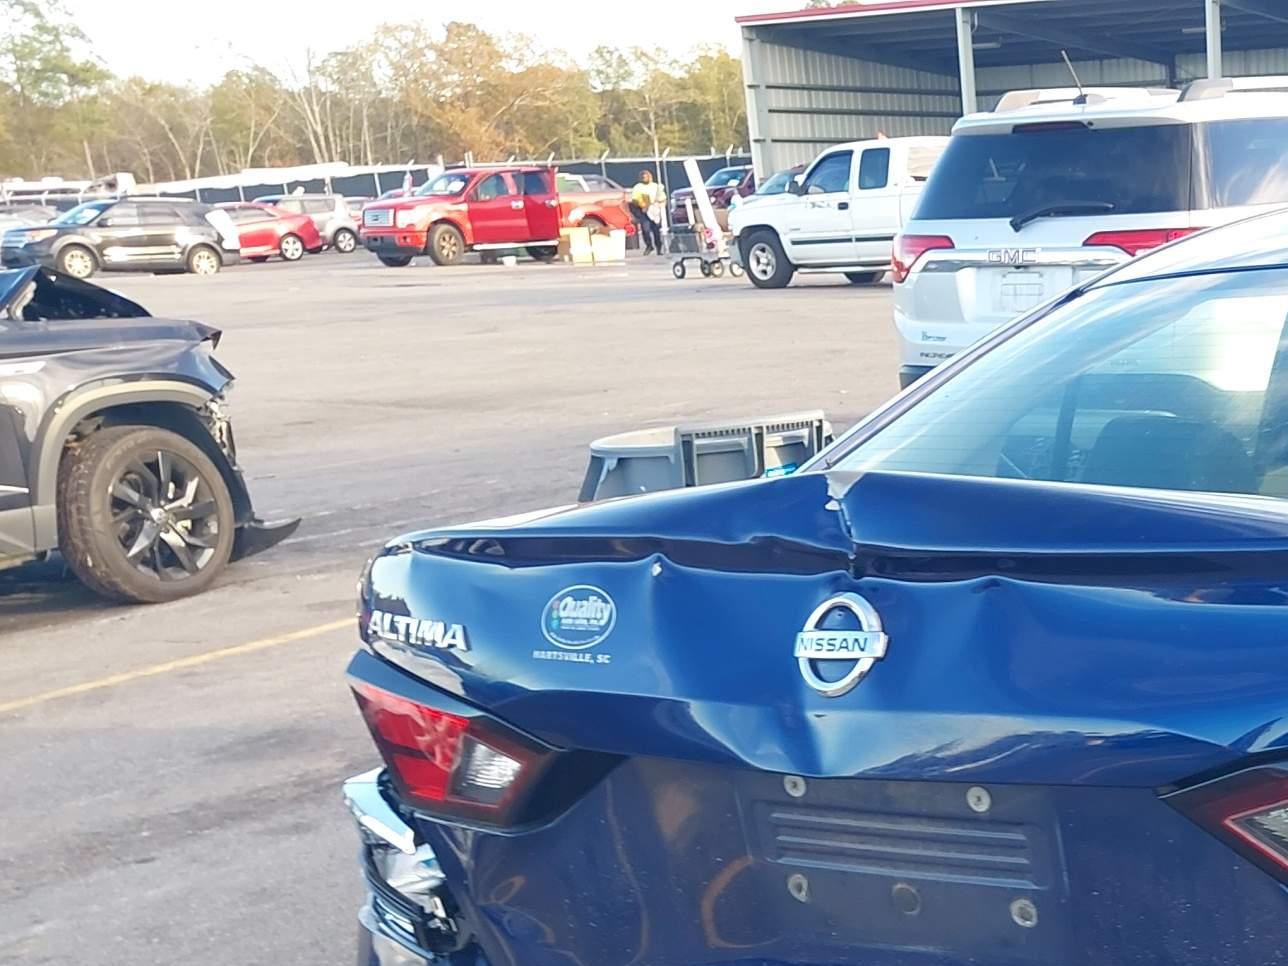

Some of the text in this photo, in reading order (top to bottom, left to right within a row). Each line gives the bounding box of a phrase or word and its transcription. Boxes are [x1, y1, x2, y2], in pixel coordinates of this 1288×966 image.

[987, 248, 1041, 264] GMC
[559, 596, 612, 626] Quality
[367, 610, 468, 651] ALTIMA
[798, 637, 868, 652] NISSAN
[596, 654, 612, 664] SC
